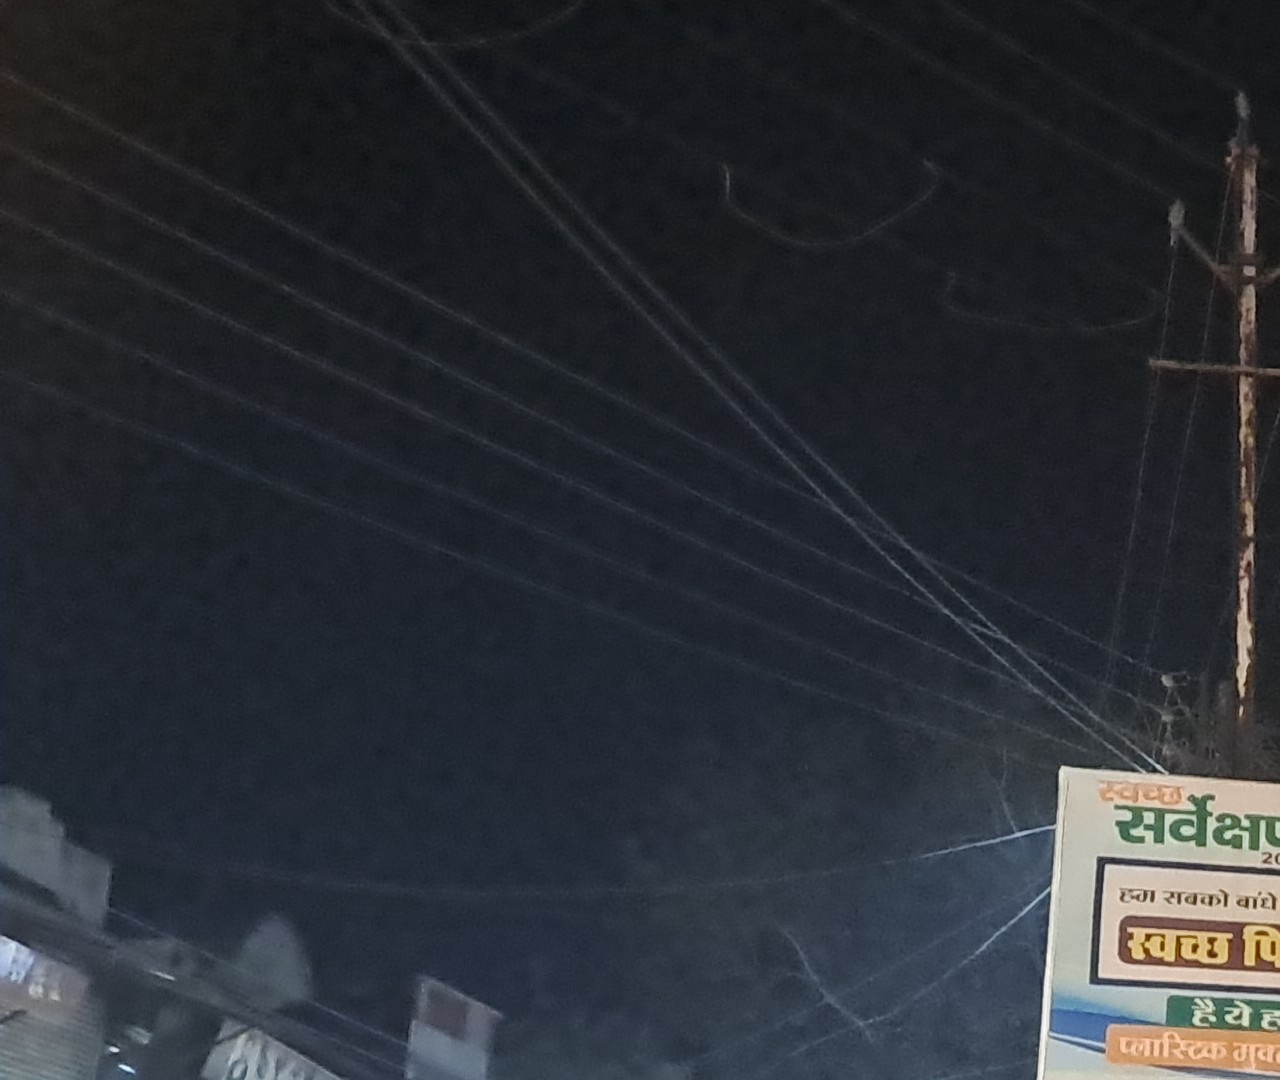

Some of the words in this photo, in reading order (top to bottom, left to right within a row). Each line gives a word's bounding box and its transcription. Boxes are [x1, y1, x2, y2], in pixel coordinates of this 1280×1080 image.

[1099, 780, 1184, 806] स्वच्छ
[1119, 887, 1156, 904] हम
[1162, 889, 1230, 908] सबको
[1127, 926, 1233, 965] स्वच्छ
[1191, 998, 1217, 1027] है
[1224, 1000, 1253, 1028] ये
[1119, 1031, 1227, 1061] प्लास्टिक
